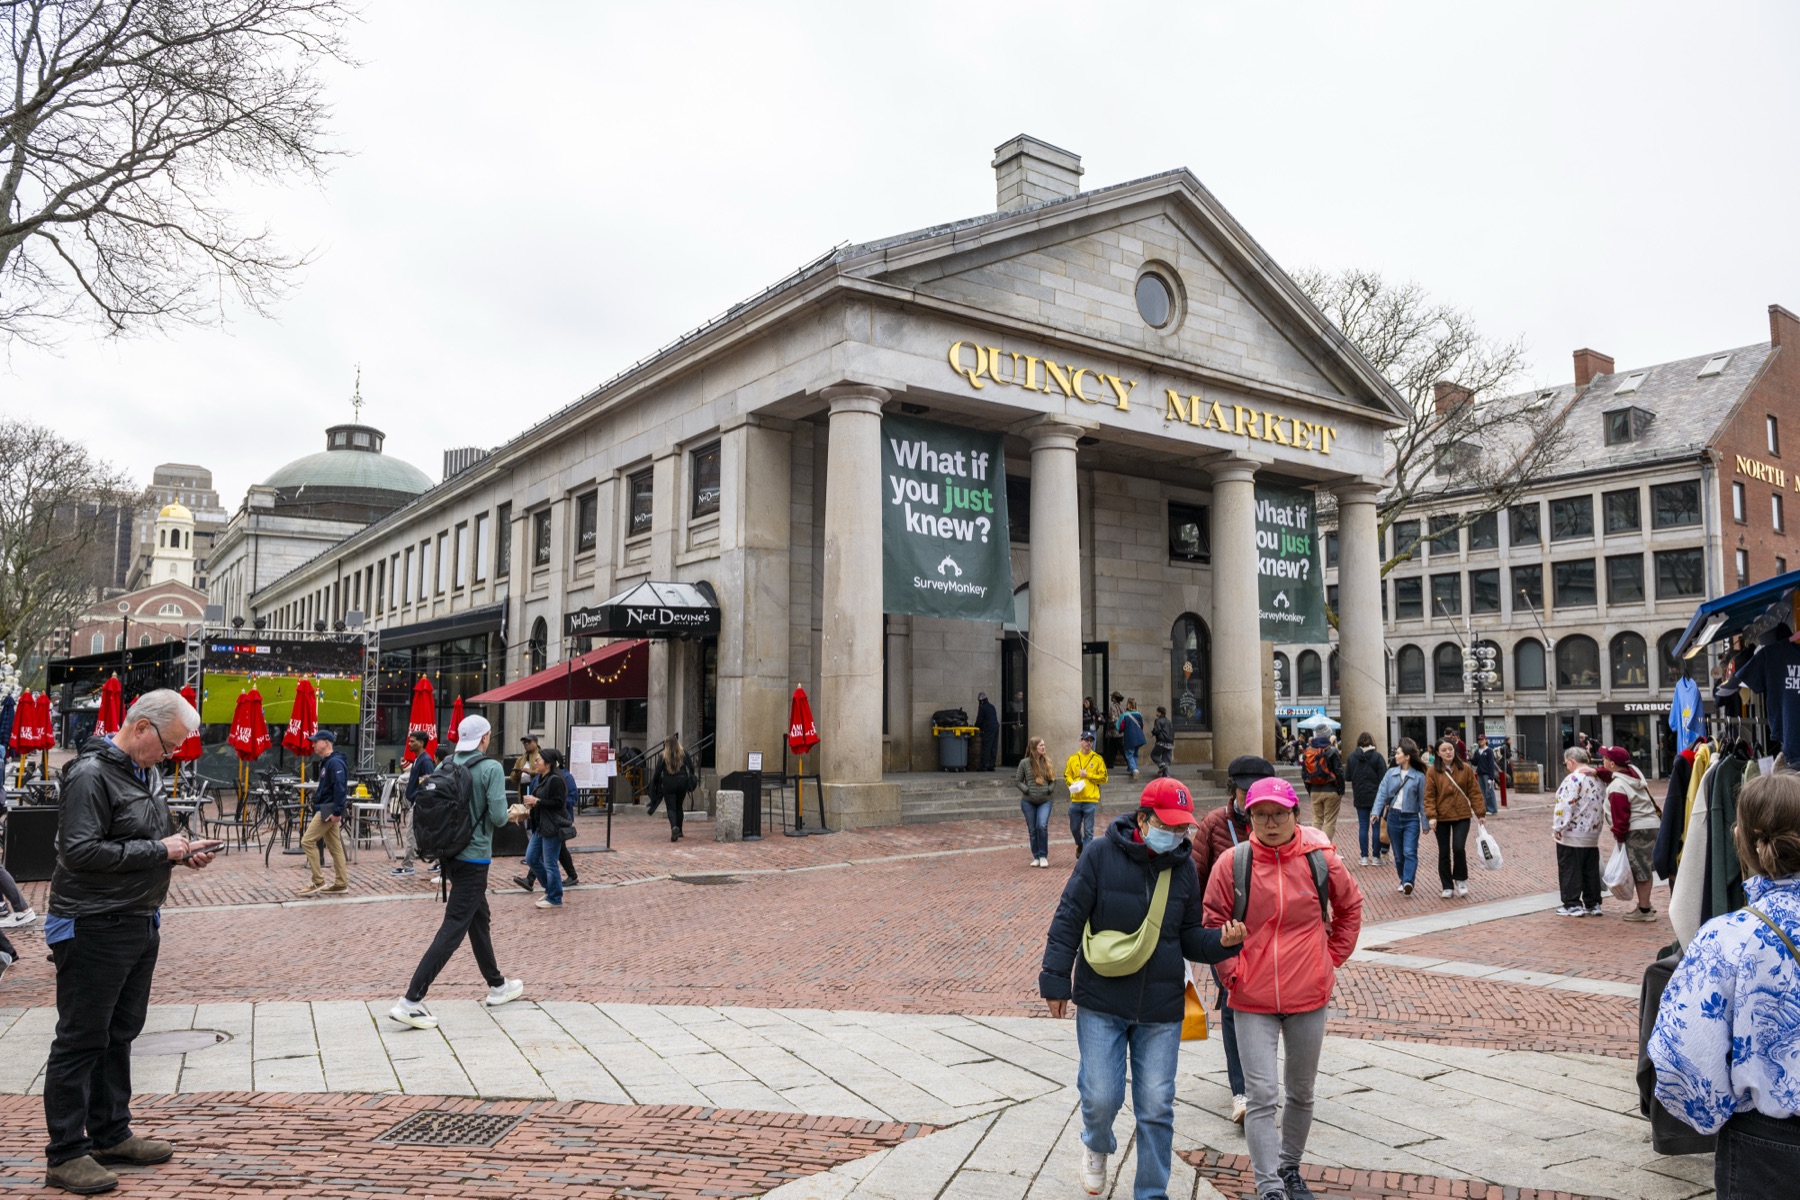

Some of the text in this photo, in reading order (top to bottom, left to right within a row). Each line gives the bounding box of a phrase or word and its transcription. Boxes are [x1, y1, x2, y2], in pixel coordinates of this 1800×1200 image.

[949, 341, 1337, 455] QUINCY MARKET
[890, 438, 989, 481] What if
[1735, 454, 1785, 488] NORTH
[890, 475, 994, 514] you just
[905, 502, 991, 543] knew?
[1296, 505, 1308, 529] if
[1256, 527, 1311, 557] ou just
[914, 576, 985, 598] SurveyMonkey
[571, 613, 581, 633] Ned
[626, 608, 656, 627] Ned
[1624, 703, 1672, 711] STARBUC
[1176, 789, 1187, 806] B
